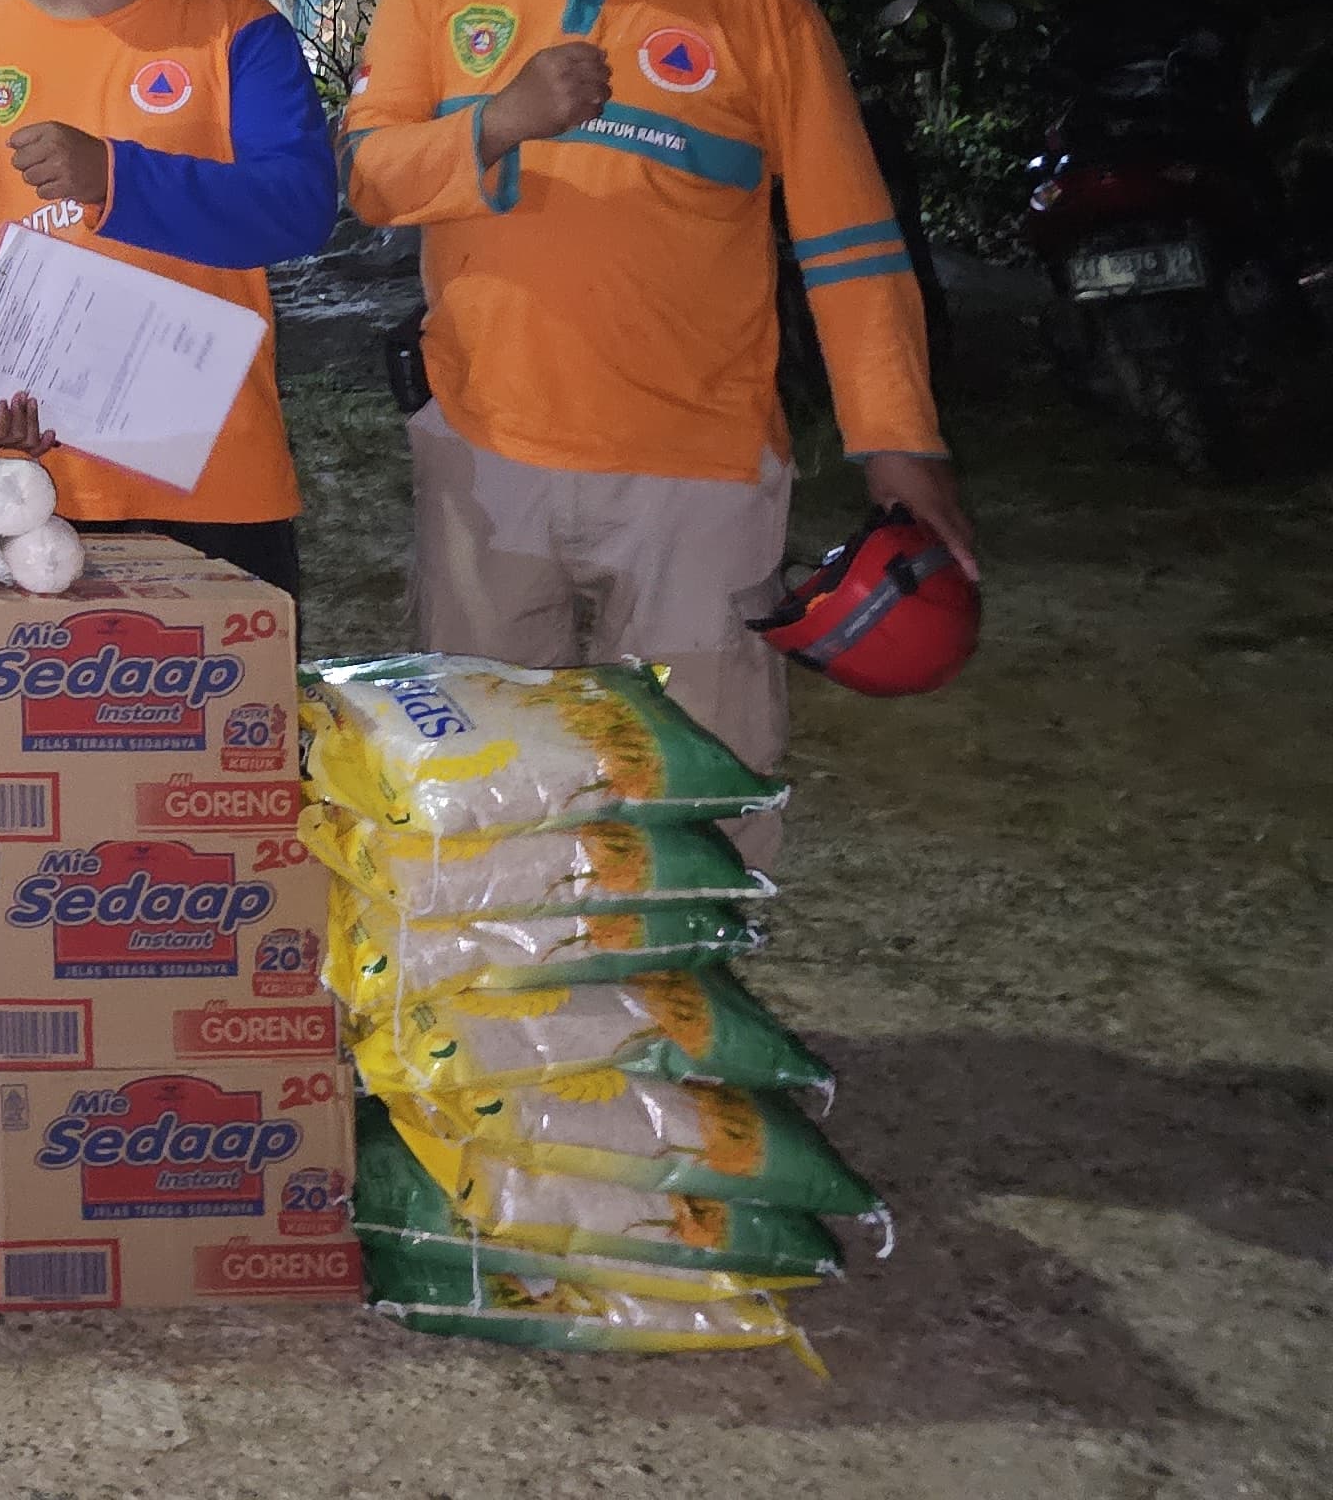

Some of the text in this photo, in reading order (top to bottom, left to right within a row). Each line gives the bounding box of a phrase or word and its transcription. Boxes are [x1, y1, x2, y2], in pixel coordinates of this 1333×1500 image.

[9, 622, 71, 648] Mie
[96, 703, 182, 723] Instant
[165, 790, 291, 818] GORENG
[39, 851, 101, 875] Mie
[6, 870, 276, 930] Sedaap
[129, 929, 214, 950] Instant
[200, 1015, 326, 1043] GORENG
[68, 1089, 131, 1116] Mie
[36, 1111, 302, 1171] Sedaap
[156, 1169, 244, 1190] Instant
[222, 1252, 347, 1279] GORENG
